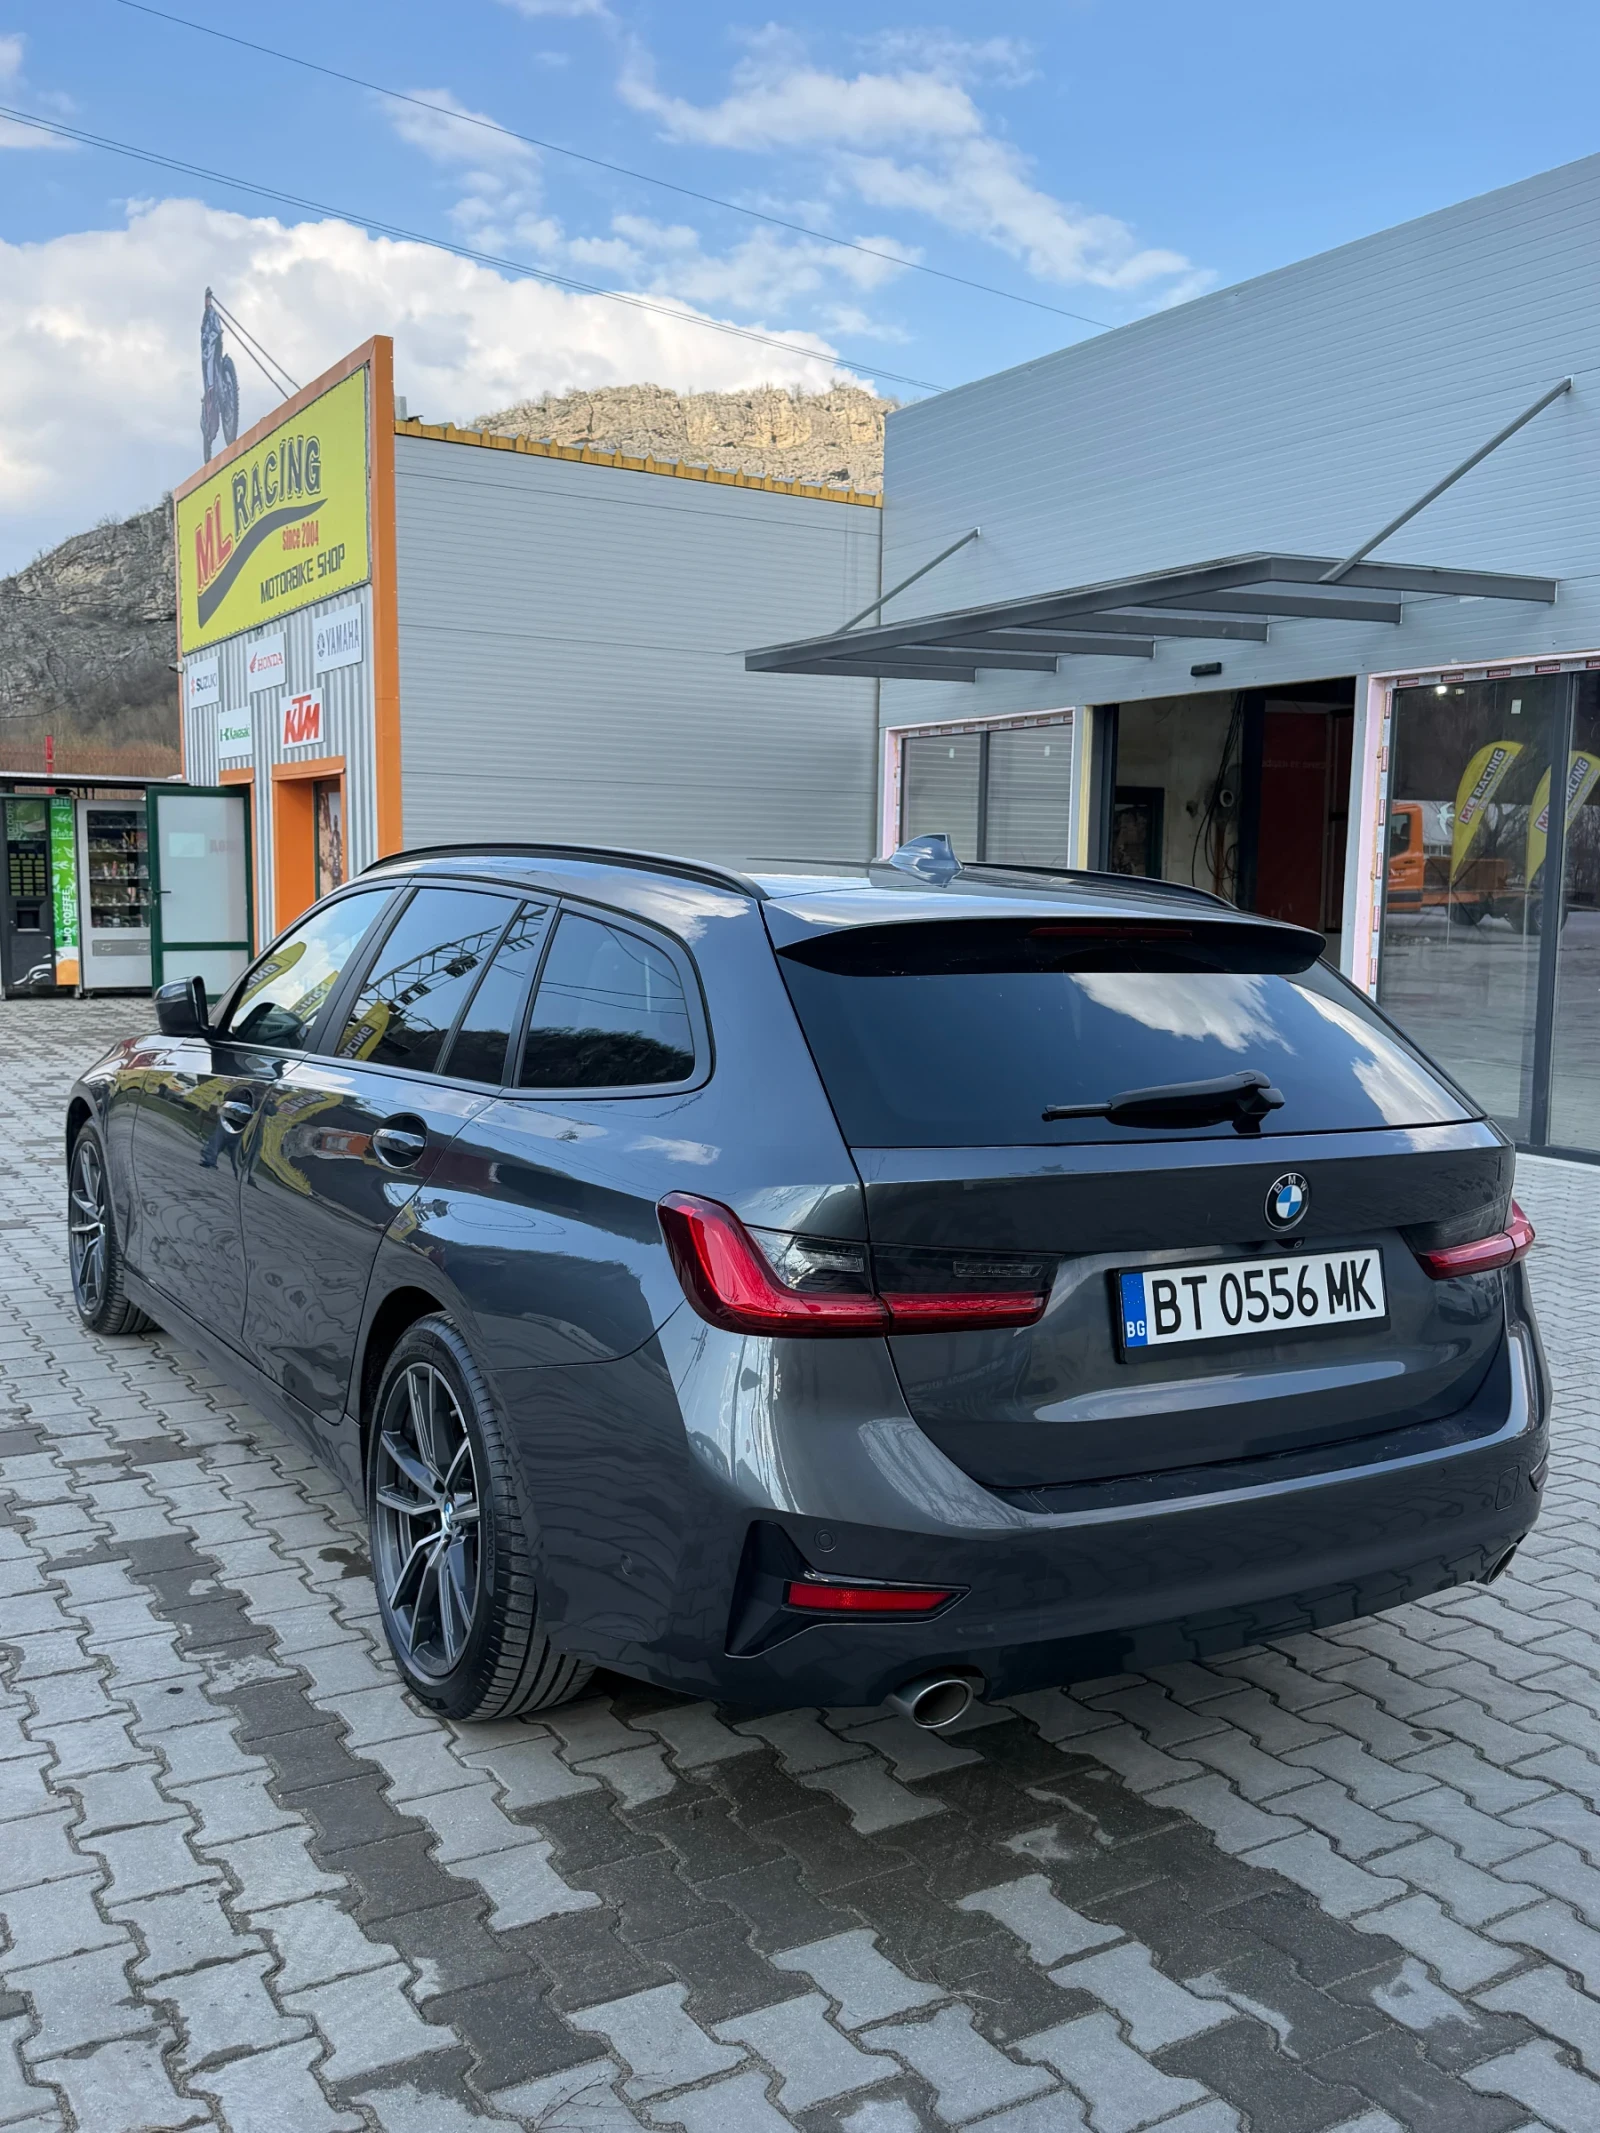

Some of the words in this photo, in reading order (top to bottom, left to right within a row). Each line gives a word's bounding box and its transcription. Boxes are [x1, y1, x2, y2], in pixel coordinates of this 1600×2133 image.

[195, 494, 234, 597] ML
[231, 434, 321, 542] RACING
[301, 520, 319, 548] 2004
[260, 558, 314, 604] MOTORBIKE
[317, 543, 345, 578] SHOP
[325, 618, 360, 657] YAMAHA
[257, 652, 283, 672] HONDA
[196, 672, 218, 692] SUZUKI
[283, 694, 321, 745] KTM
[1474, 749, 1505, 798] RACING
[62, 889, 72, 926] COFFEE
[1152, 1275, 1207, 1335] BT
[1219, 1265, 1319, 1326] 0556
[1324, 1258, 1376, 1315] MK
[1126, 1320, 1146, 1338] BG
